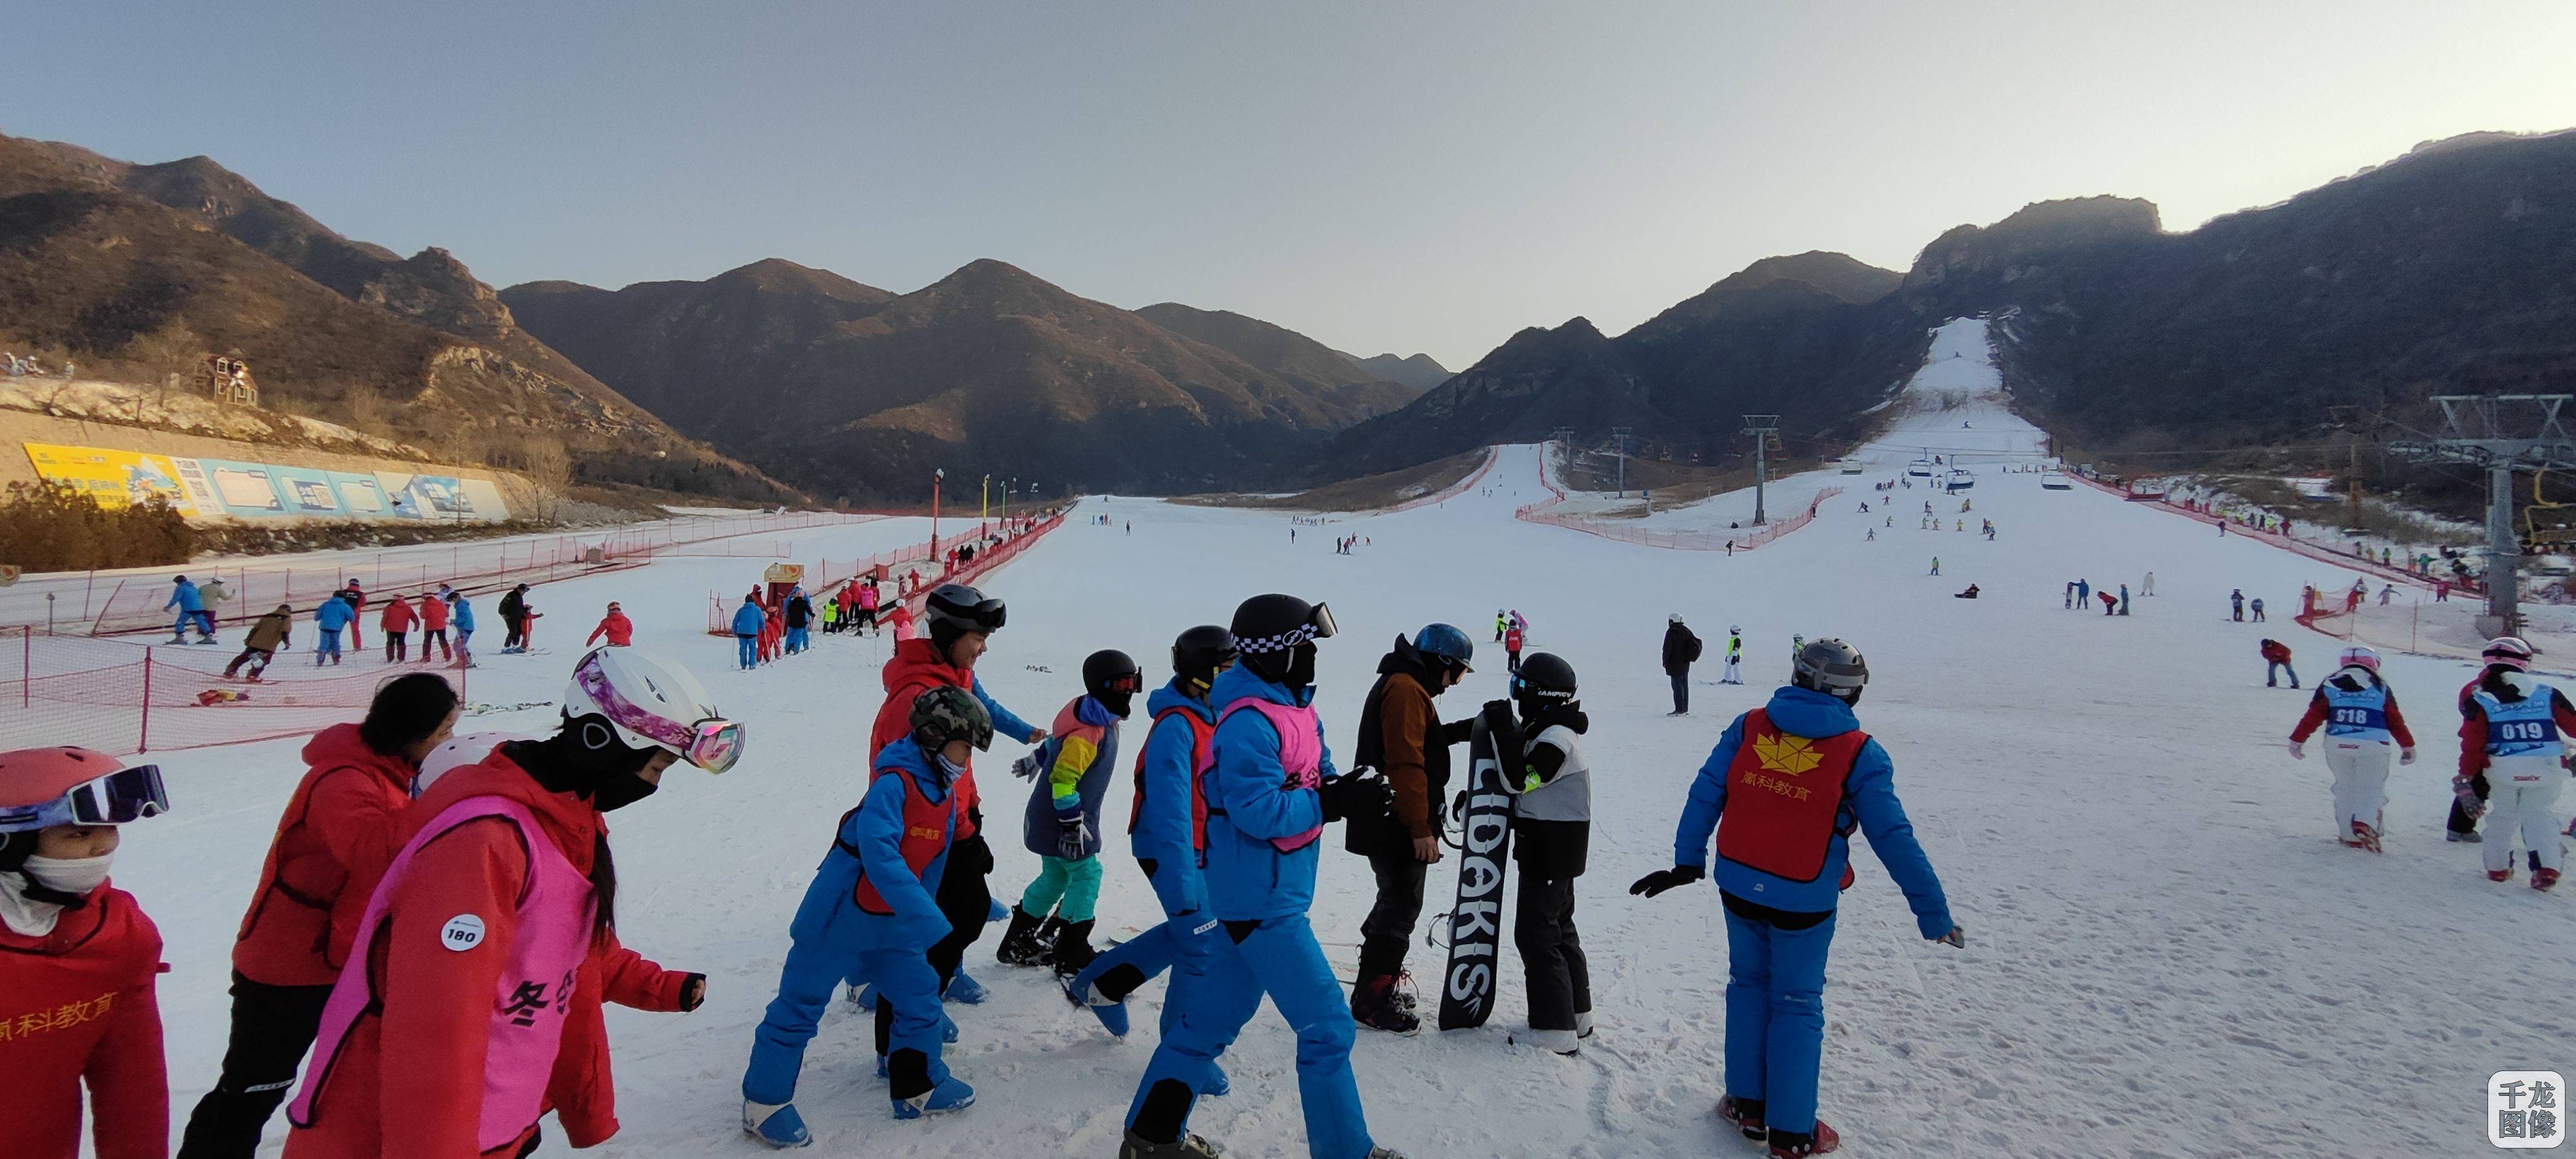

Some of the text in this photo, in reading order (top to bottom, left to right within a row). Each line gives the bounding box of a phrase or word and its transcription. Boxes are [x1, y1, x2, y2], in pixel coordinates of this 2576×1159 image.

[2502, 722, 2543, 740] 019
[1450, 758, 1511, 1001] LIDAKIS
[447, 929, 476, 943] 180
